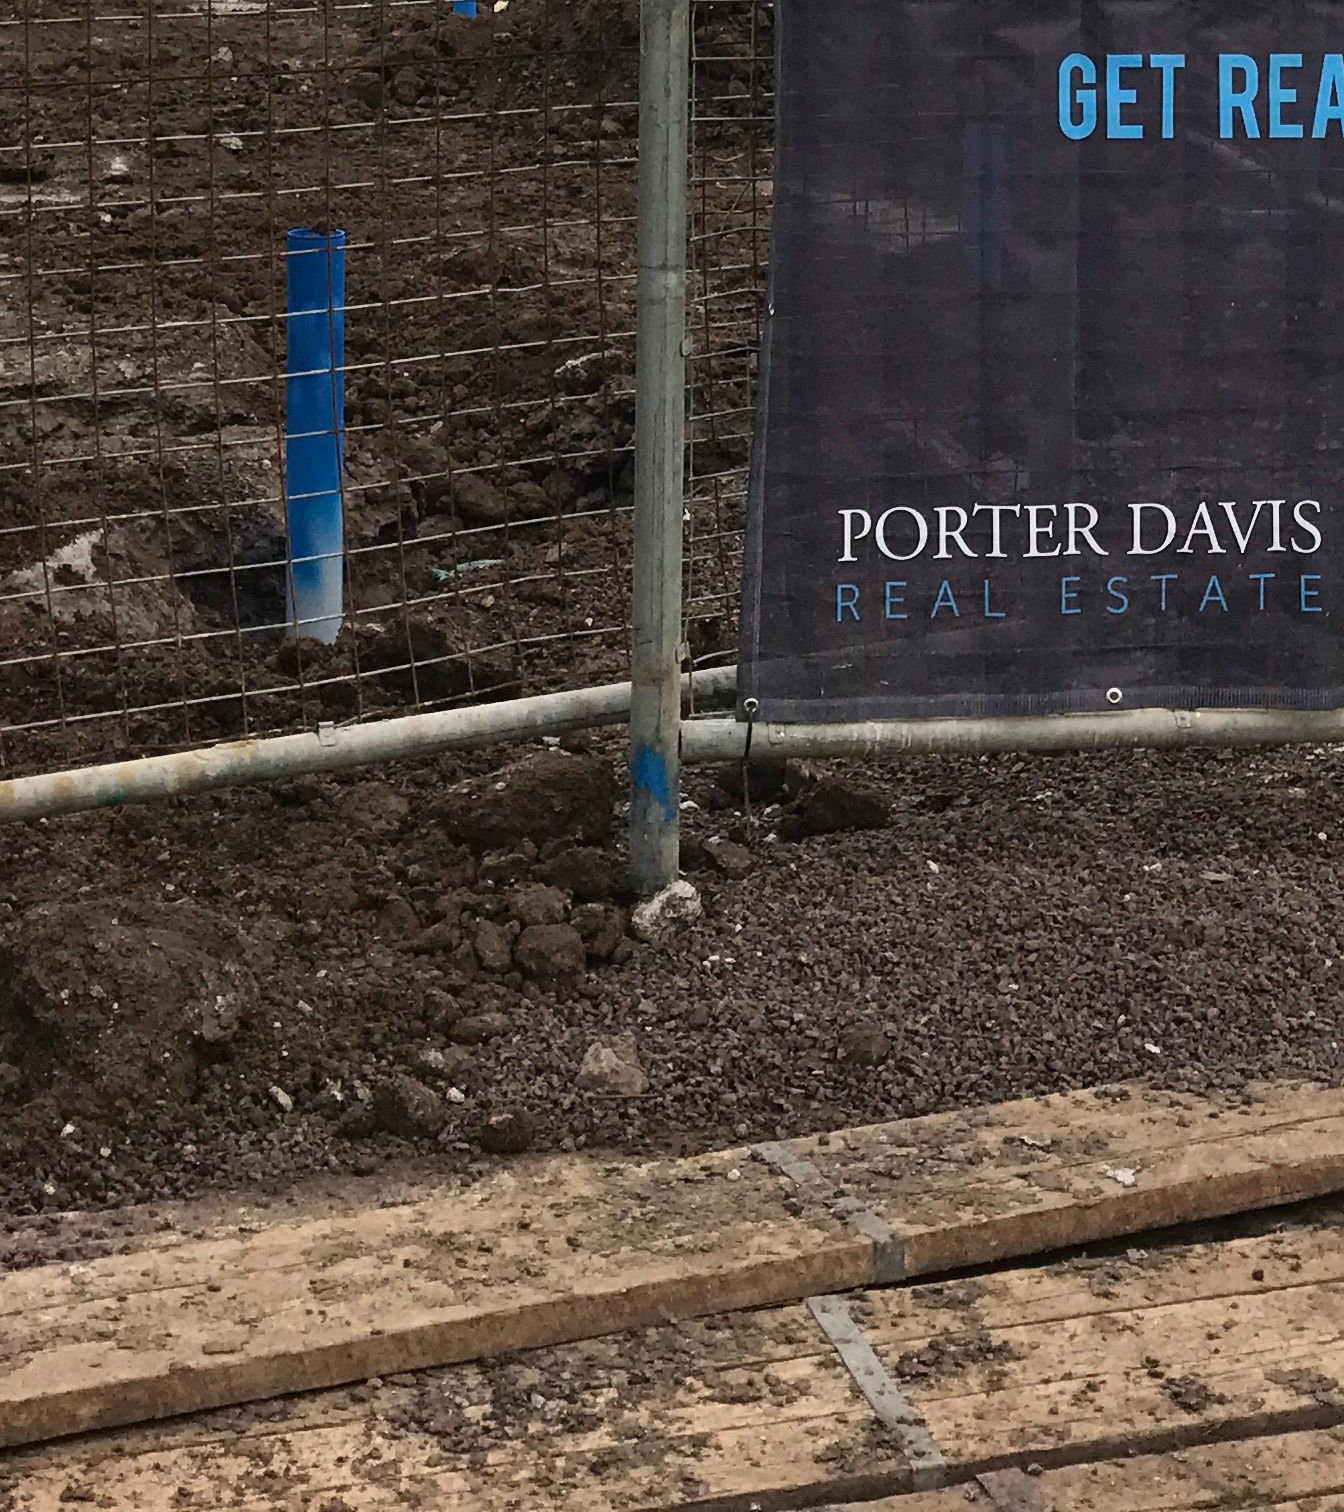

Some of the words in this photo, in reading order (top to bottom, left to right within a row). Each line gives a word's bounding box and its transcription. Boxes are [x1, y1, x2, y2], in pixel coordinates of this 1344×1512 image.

[1058, 52, 1186, 141] GET
[837, 502, 1110, 562] PORTER
[1127, 499, 1322, 555] DAVIS
[836, 578, 1006, 622] REAL
[1060, 572, 1323, 614] ESTATE
